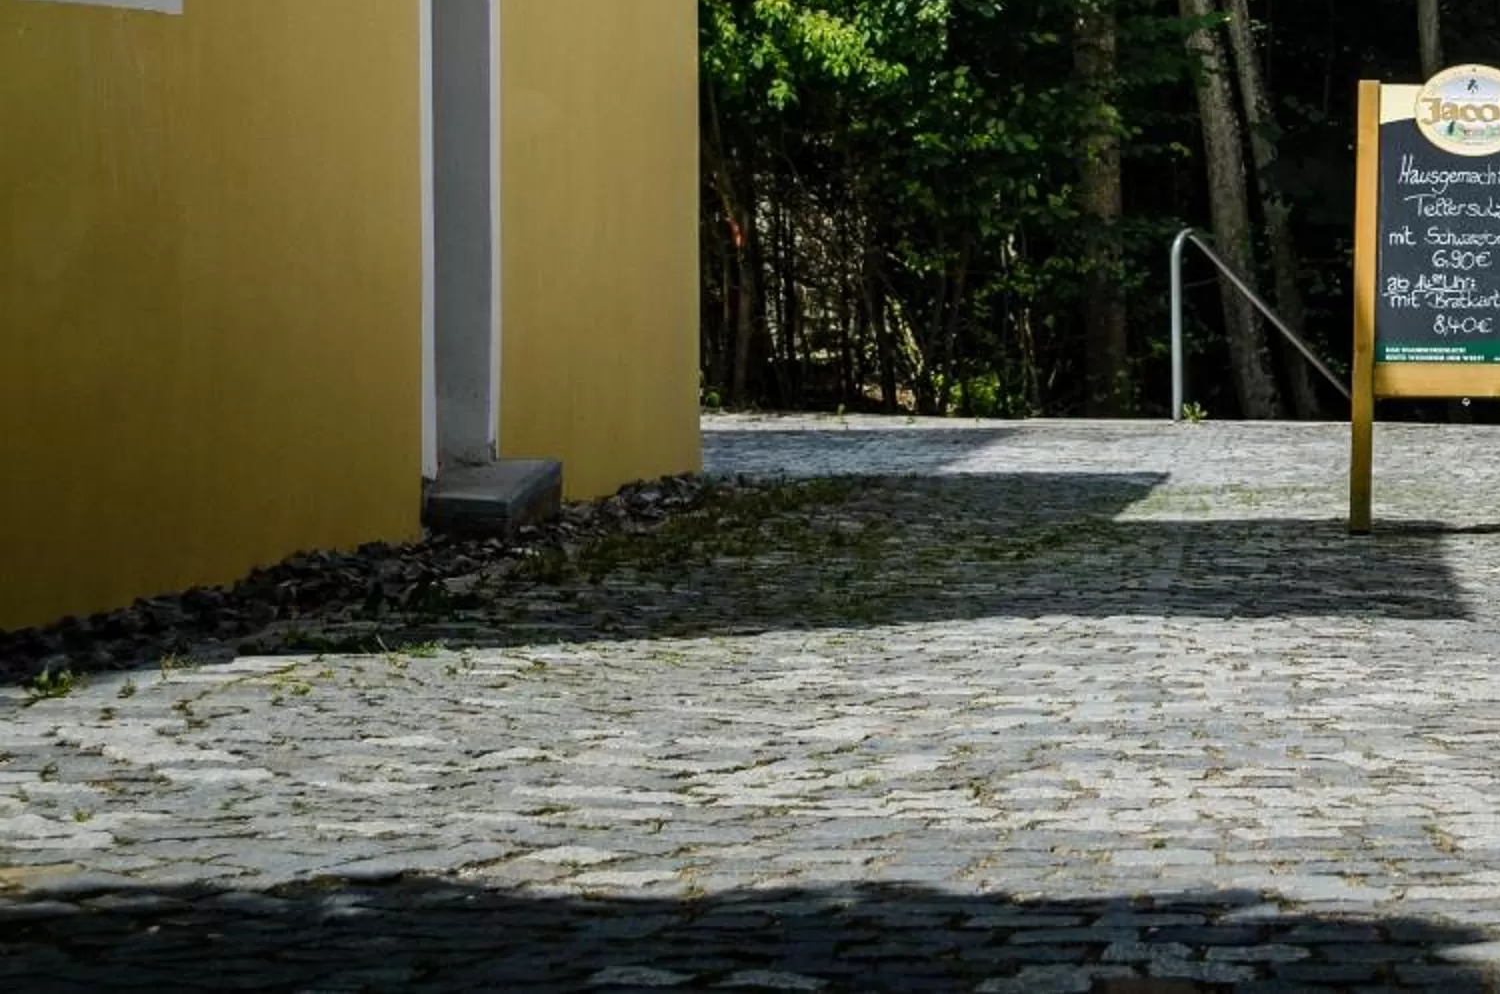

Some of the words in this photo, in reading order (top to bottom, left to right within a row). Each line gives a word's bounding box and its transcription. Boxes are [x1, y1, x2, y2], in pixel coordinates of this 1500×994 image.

[1388, 225, 1417, 246] mit
[1386, 274, 1411, 292] ab
[1390, 289, 1420, 309] mit
